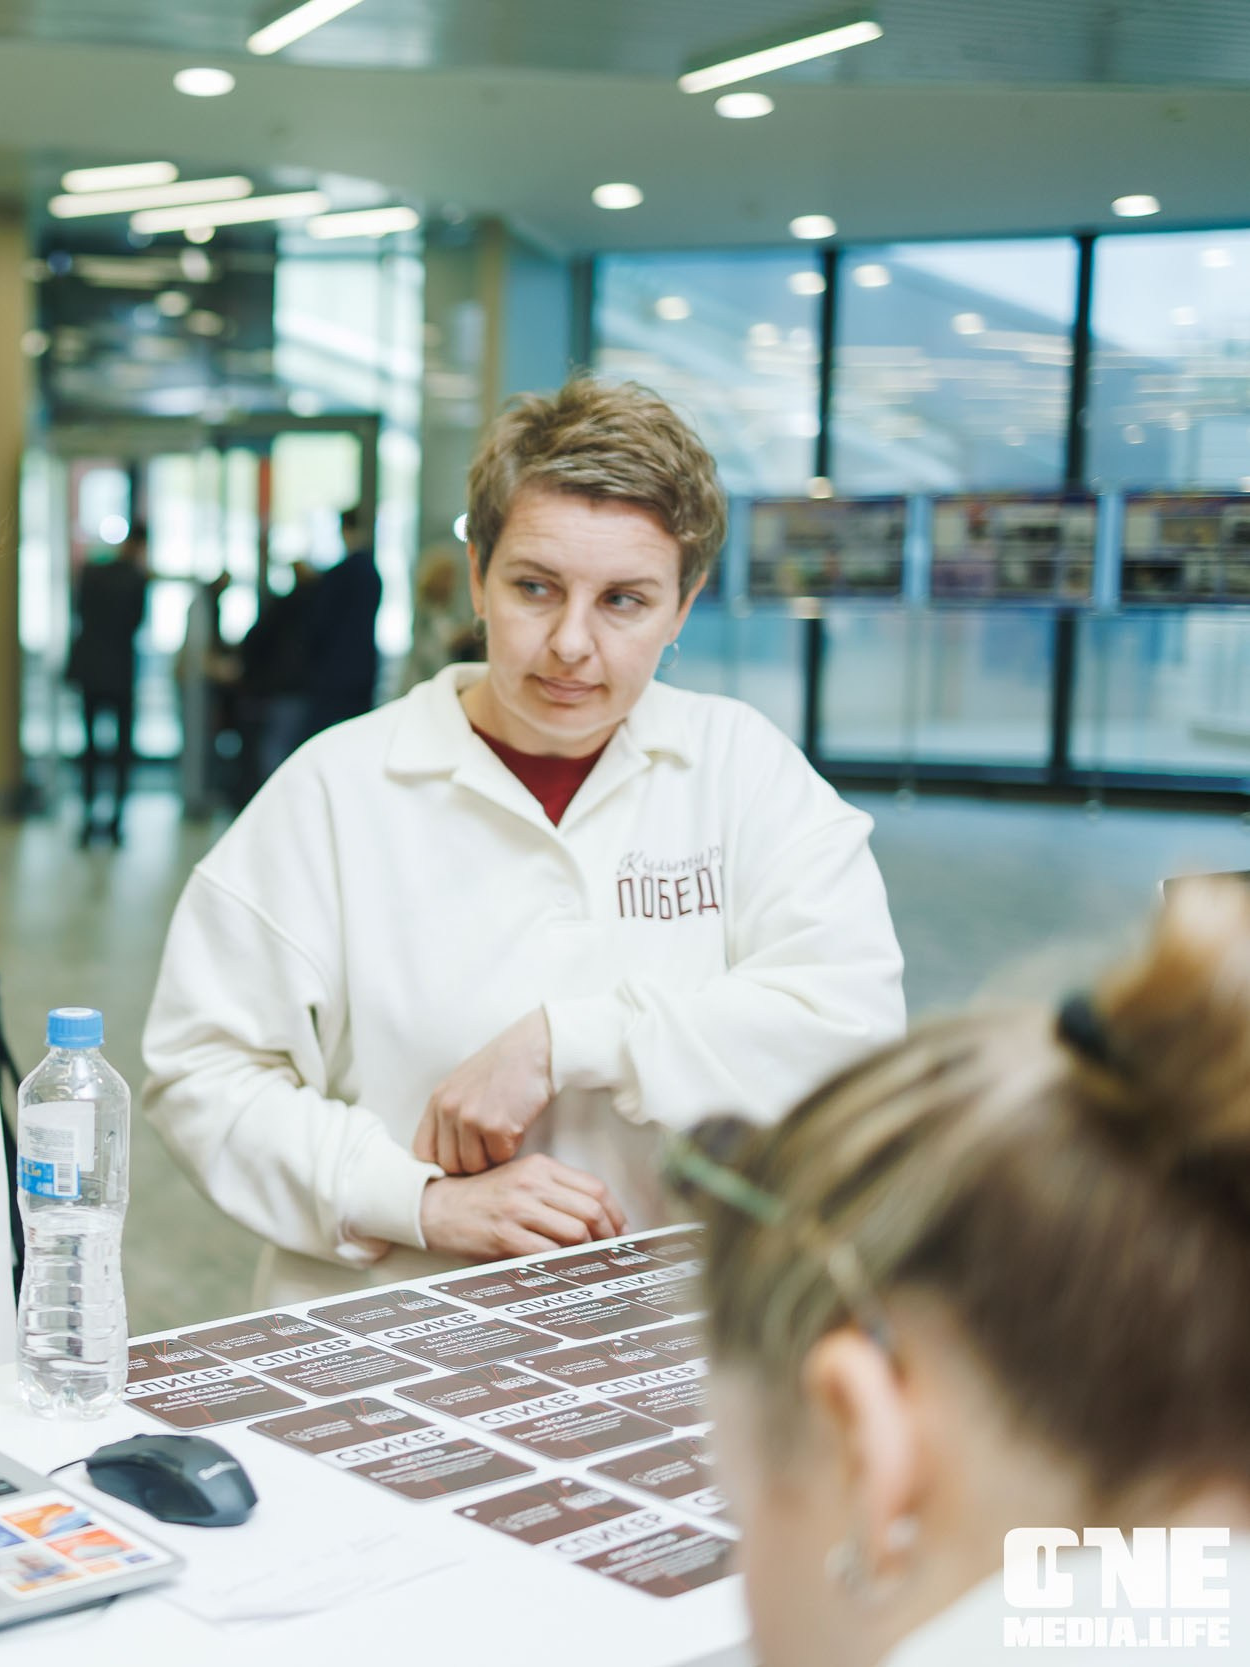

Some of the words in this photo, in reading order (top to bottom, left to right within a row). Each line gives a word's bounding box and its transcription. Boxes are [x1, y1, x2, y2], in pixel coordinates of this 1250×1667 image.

[616, 845, 722, 876] Культур
[602, 1266, 687, 1291] СПИКЕР
[505, 1290, 594, 1314] СПИКЕР
[383, 1313, 478, 1340] СПИКЕР
[252, 1338, 351, 1367] СПИКЕР
[300, 1353, 352, 1370] БОРИСОВ
[124, 1368, 235, 1395] СПИКЕР
[596, 1367, 697, 1394] СПИКЕР
[479, 1393, 580, 1424] СПИКЕР
[336, 1429, 446, 1462] СПИКЕР
[555, 1513, 663, 1554] СПИКЕР
